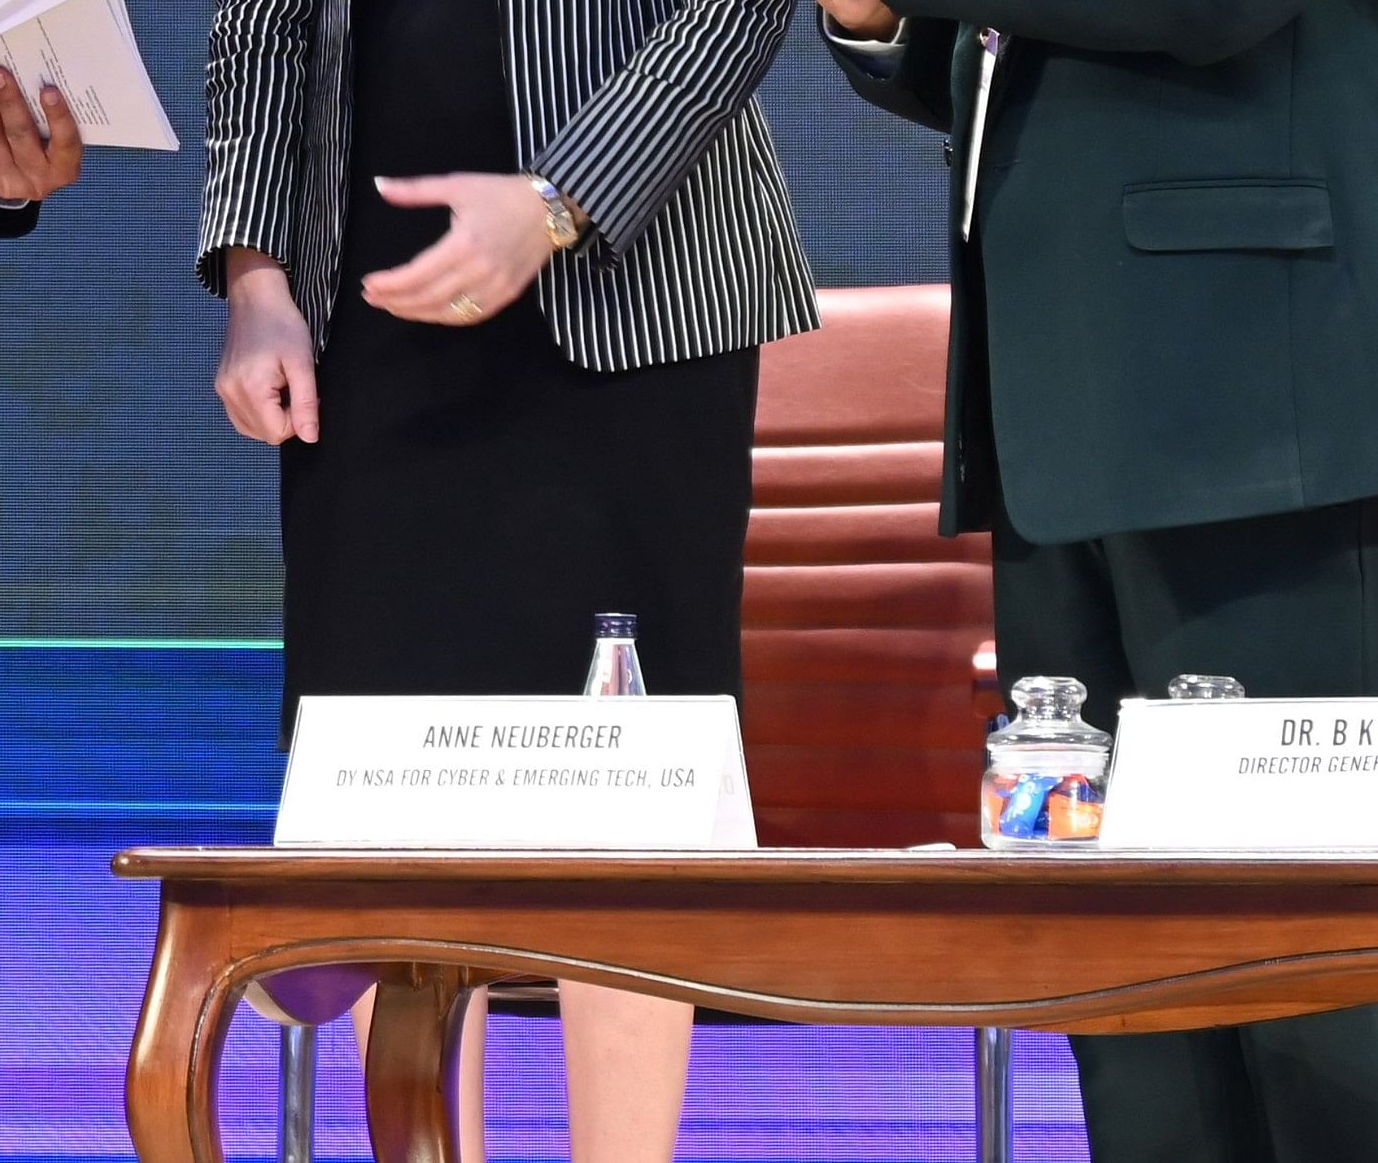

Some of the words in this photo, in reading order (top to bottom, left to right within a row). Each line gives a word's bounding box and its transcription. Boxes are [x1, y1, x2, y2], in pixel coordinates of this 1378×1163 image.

[422, 725, 484, 748] ANNE
[491, 725, 622, 749] NEUBERGER
[1281, 719, 1320, 746] DR.
[1332, 719, 1348, 746] B
[1358, 719, 1374, 746] K
[1238, 756, 1322, 775] DIRECTOR
[336, 769, 358, 787] DY
[362, 769, 394, 786] NSA
[401, 769, 432, 786] FOR
[437, 769, 490, 786] CYBER
[495, 769, 505, 786] &
[513, 769, 600, 787] EMERGING
[661, 768, 695, 787] USA
